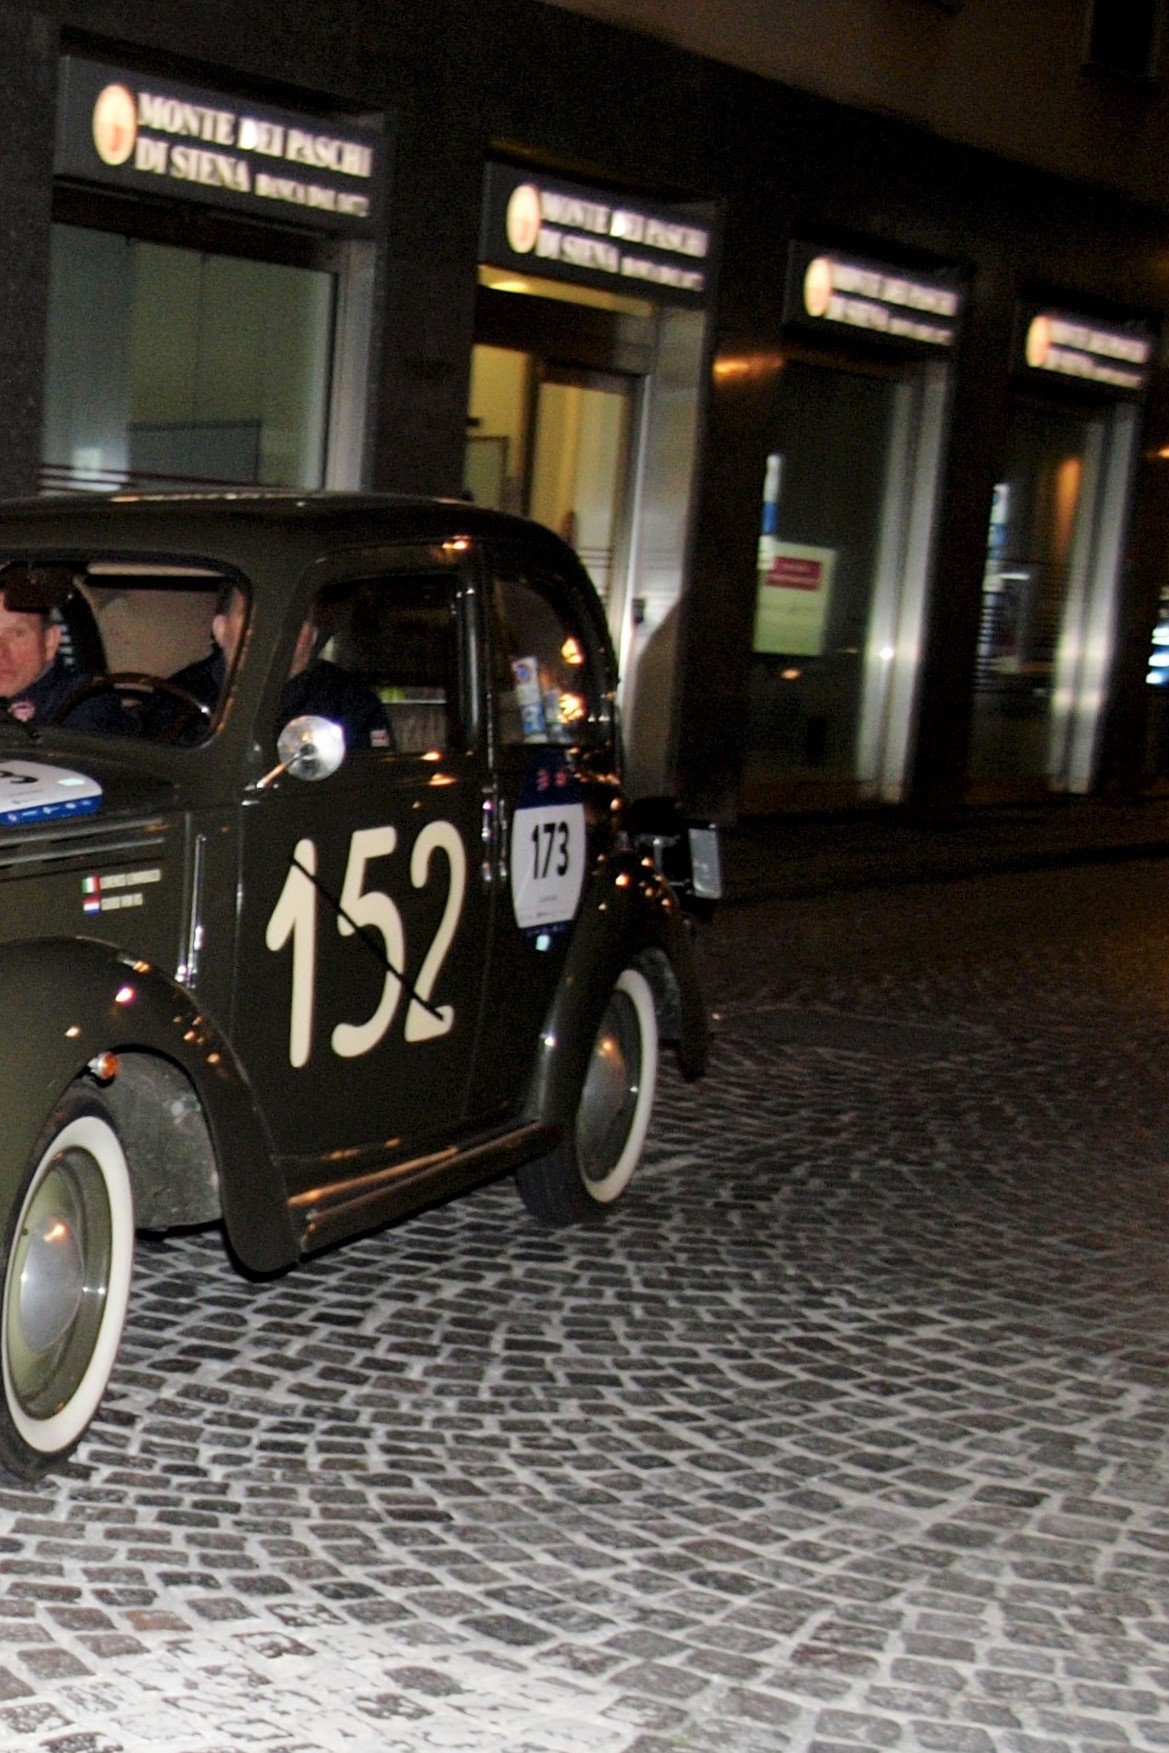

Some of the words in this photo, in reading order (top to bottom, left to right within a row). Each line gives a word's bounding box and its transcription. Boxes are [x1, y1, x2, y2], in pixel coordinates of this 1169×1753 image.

[138, 92, 235, 146] MONTE
[135, 137, 168, 174] DI
[531, 821, 570, 880] 173
[265, 820, 467, 1069] 152
